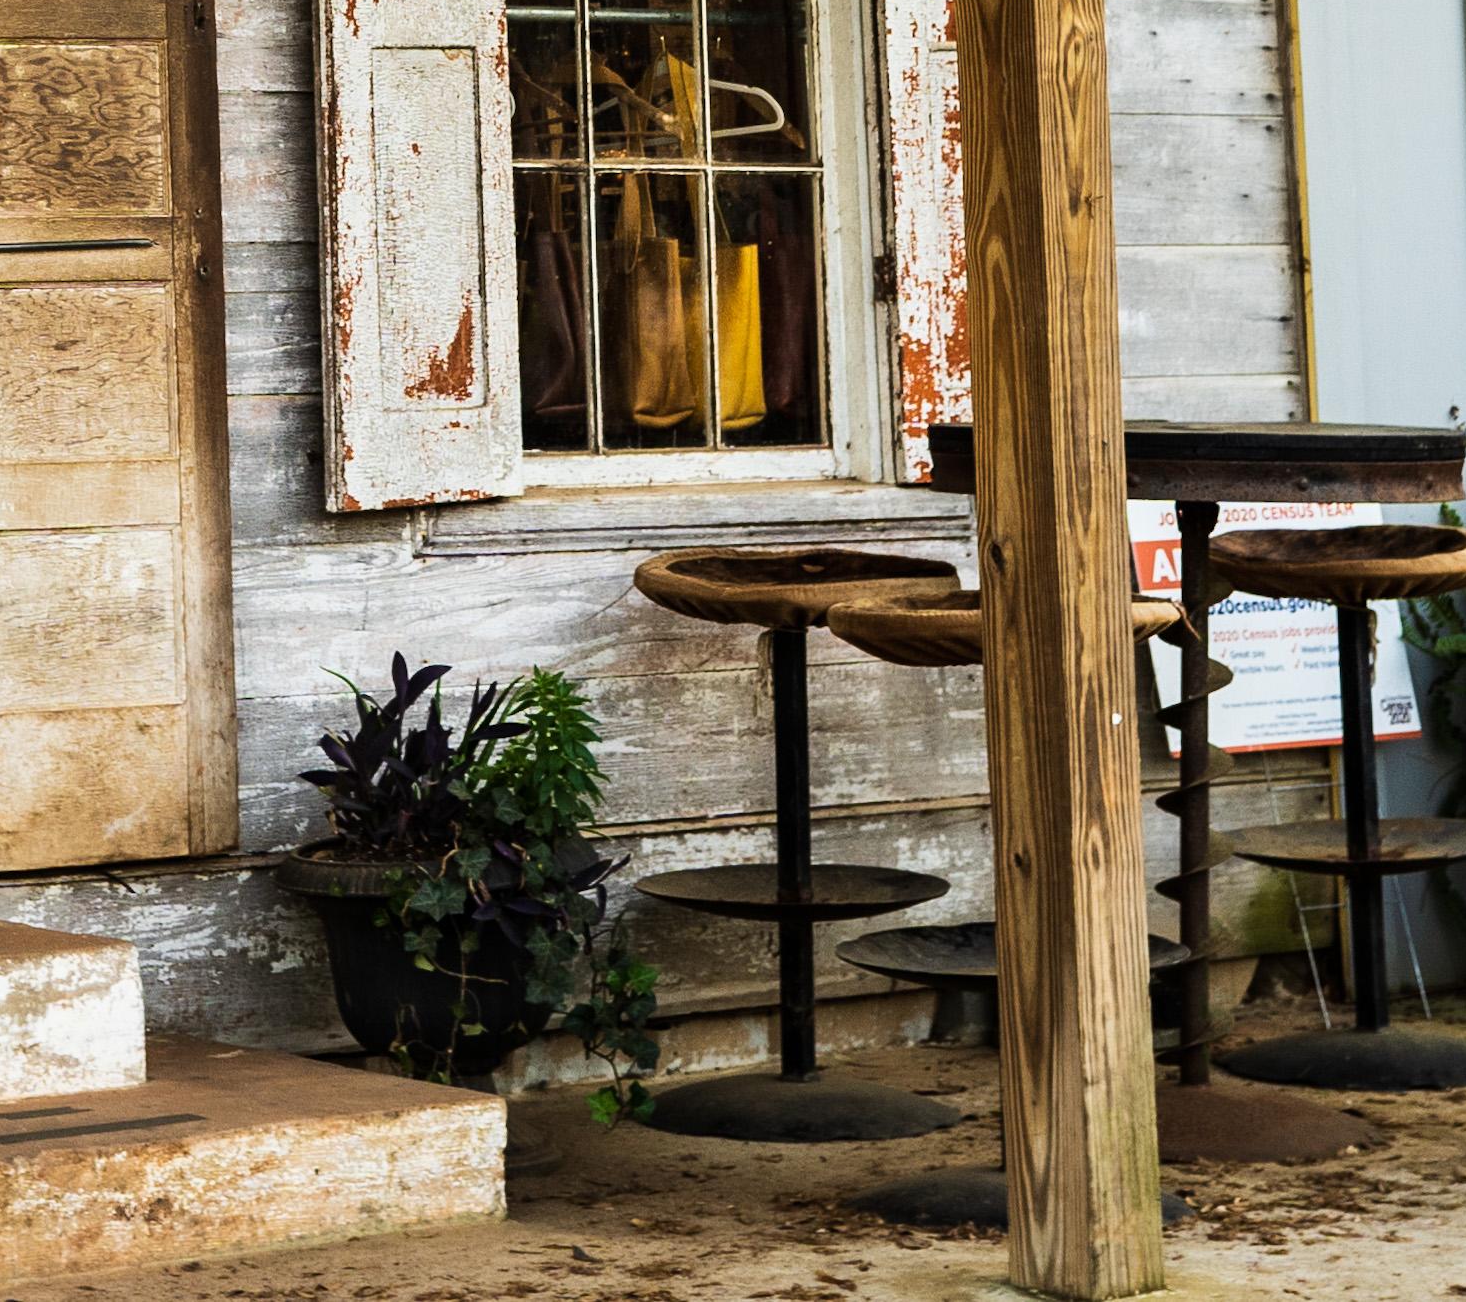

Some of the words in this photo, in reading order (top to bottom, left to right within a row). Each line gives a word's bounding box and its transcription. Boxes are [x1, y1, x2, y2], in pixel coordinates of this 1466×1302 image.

[1224, 508, 1258, 523] 2020
[1260, 502, 1315, 521] CENSUS
[1319, 502, 1355, 517] TEAM
[1212, 630, 1239, 643] 2020
[1241, 629, 1278, 640] Census
[1280, 626, 1302, 640] jobs
